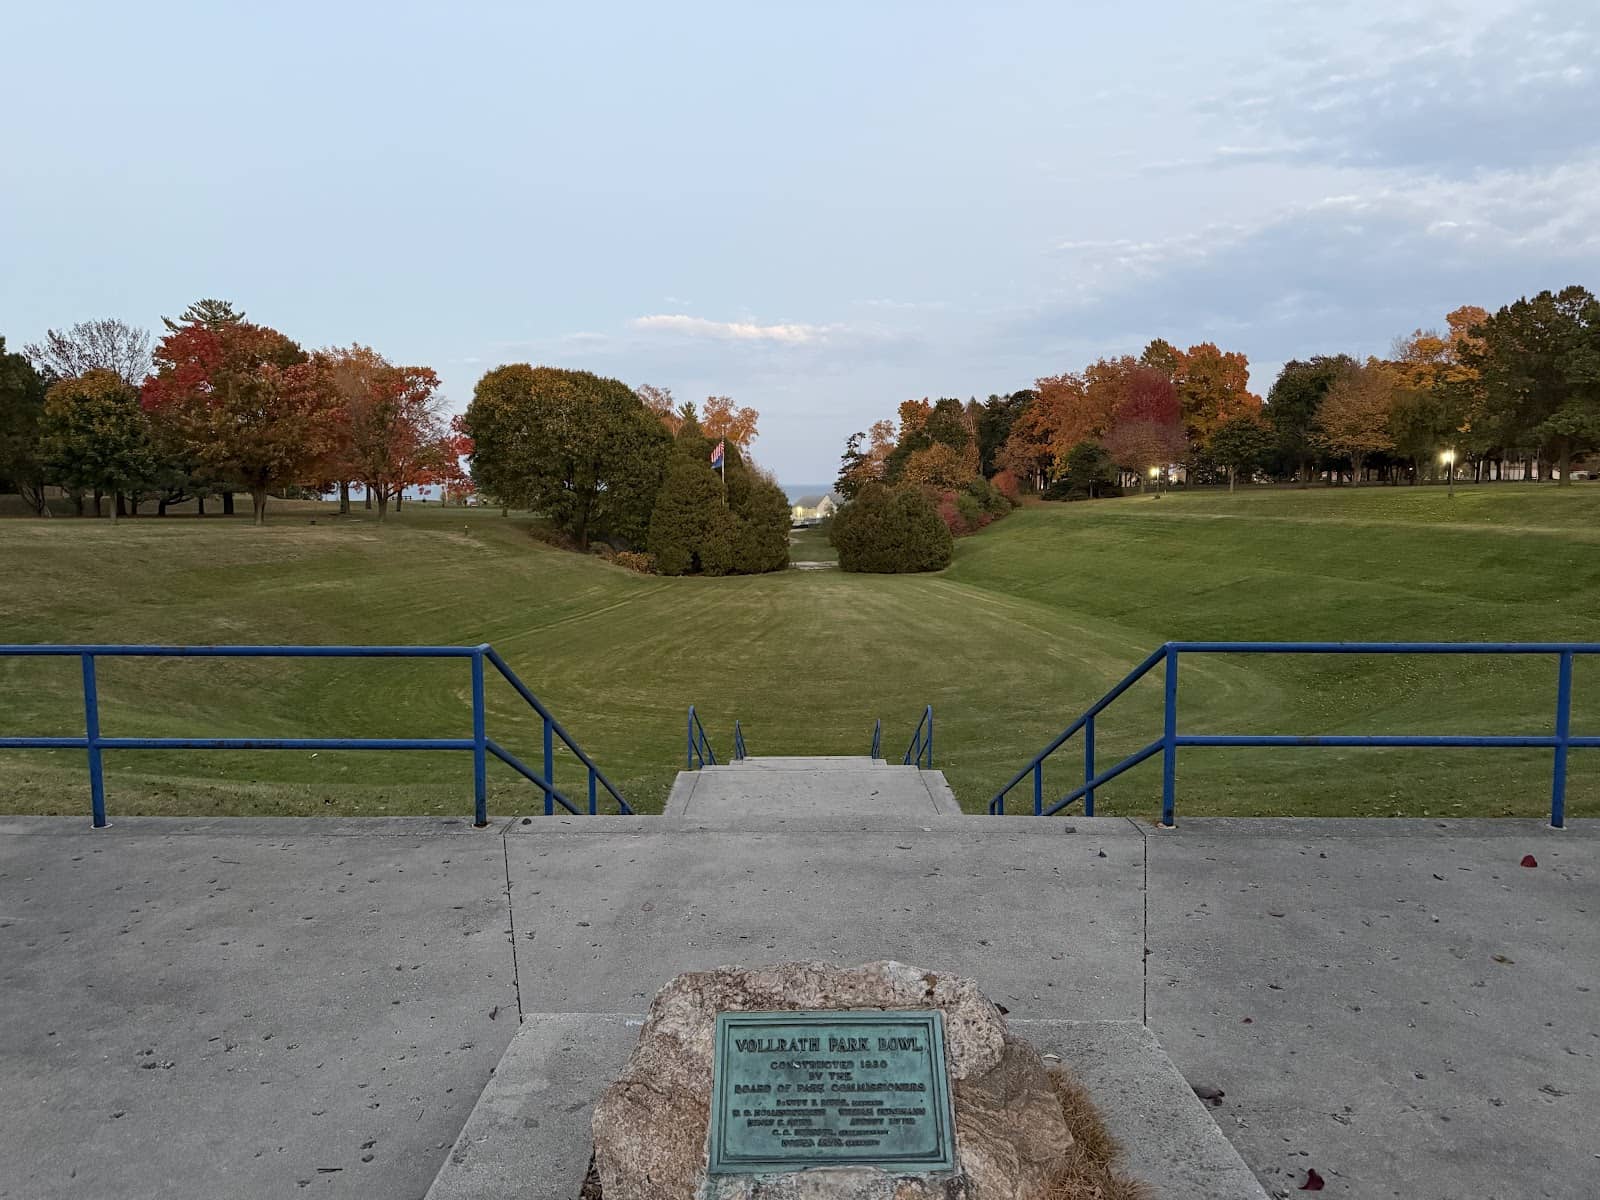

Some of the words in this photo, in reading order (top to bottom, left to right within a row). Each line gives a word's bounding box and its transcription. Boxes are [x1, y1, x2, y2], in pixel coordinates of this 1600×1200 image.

[735, 1038, 820, 1053] VOLLRATH
[828, 1037, 870, 1052] PARK
[878, 1037, 923, 1051] BOWL
[770, 1061, 854, 1070] CONSTRUCTED
[809, 1072, 823, 1080] BY
[828, 1072, 853, 1080] THE
[734, 1084, 771, 1094] BOARD
[777, 1084, 792, 1092] OF
[797, 1084, 825, 1093] PARK
[831, 1083, 926, 1092] COMMISSIONERS
